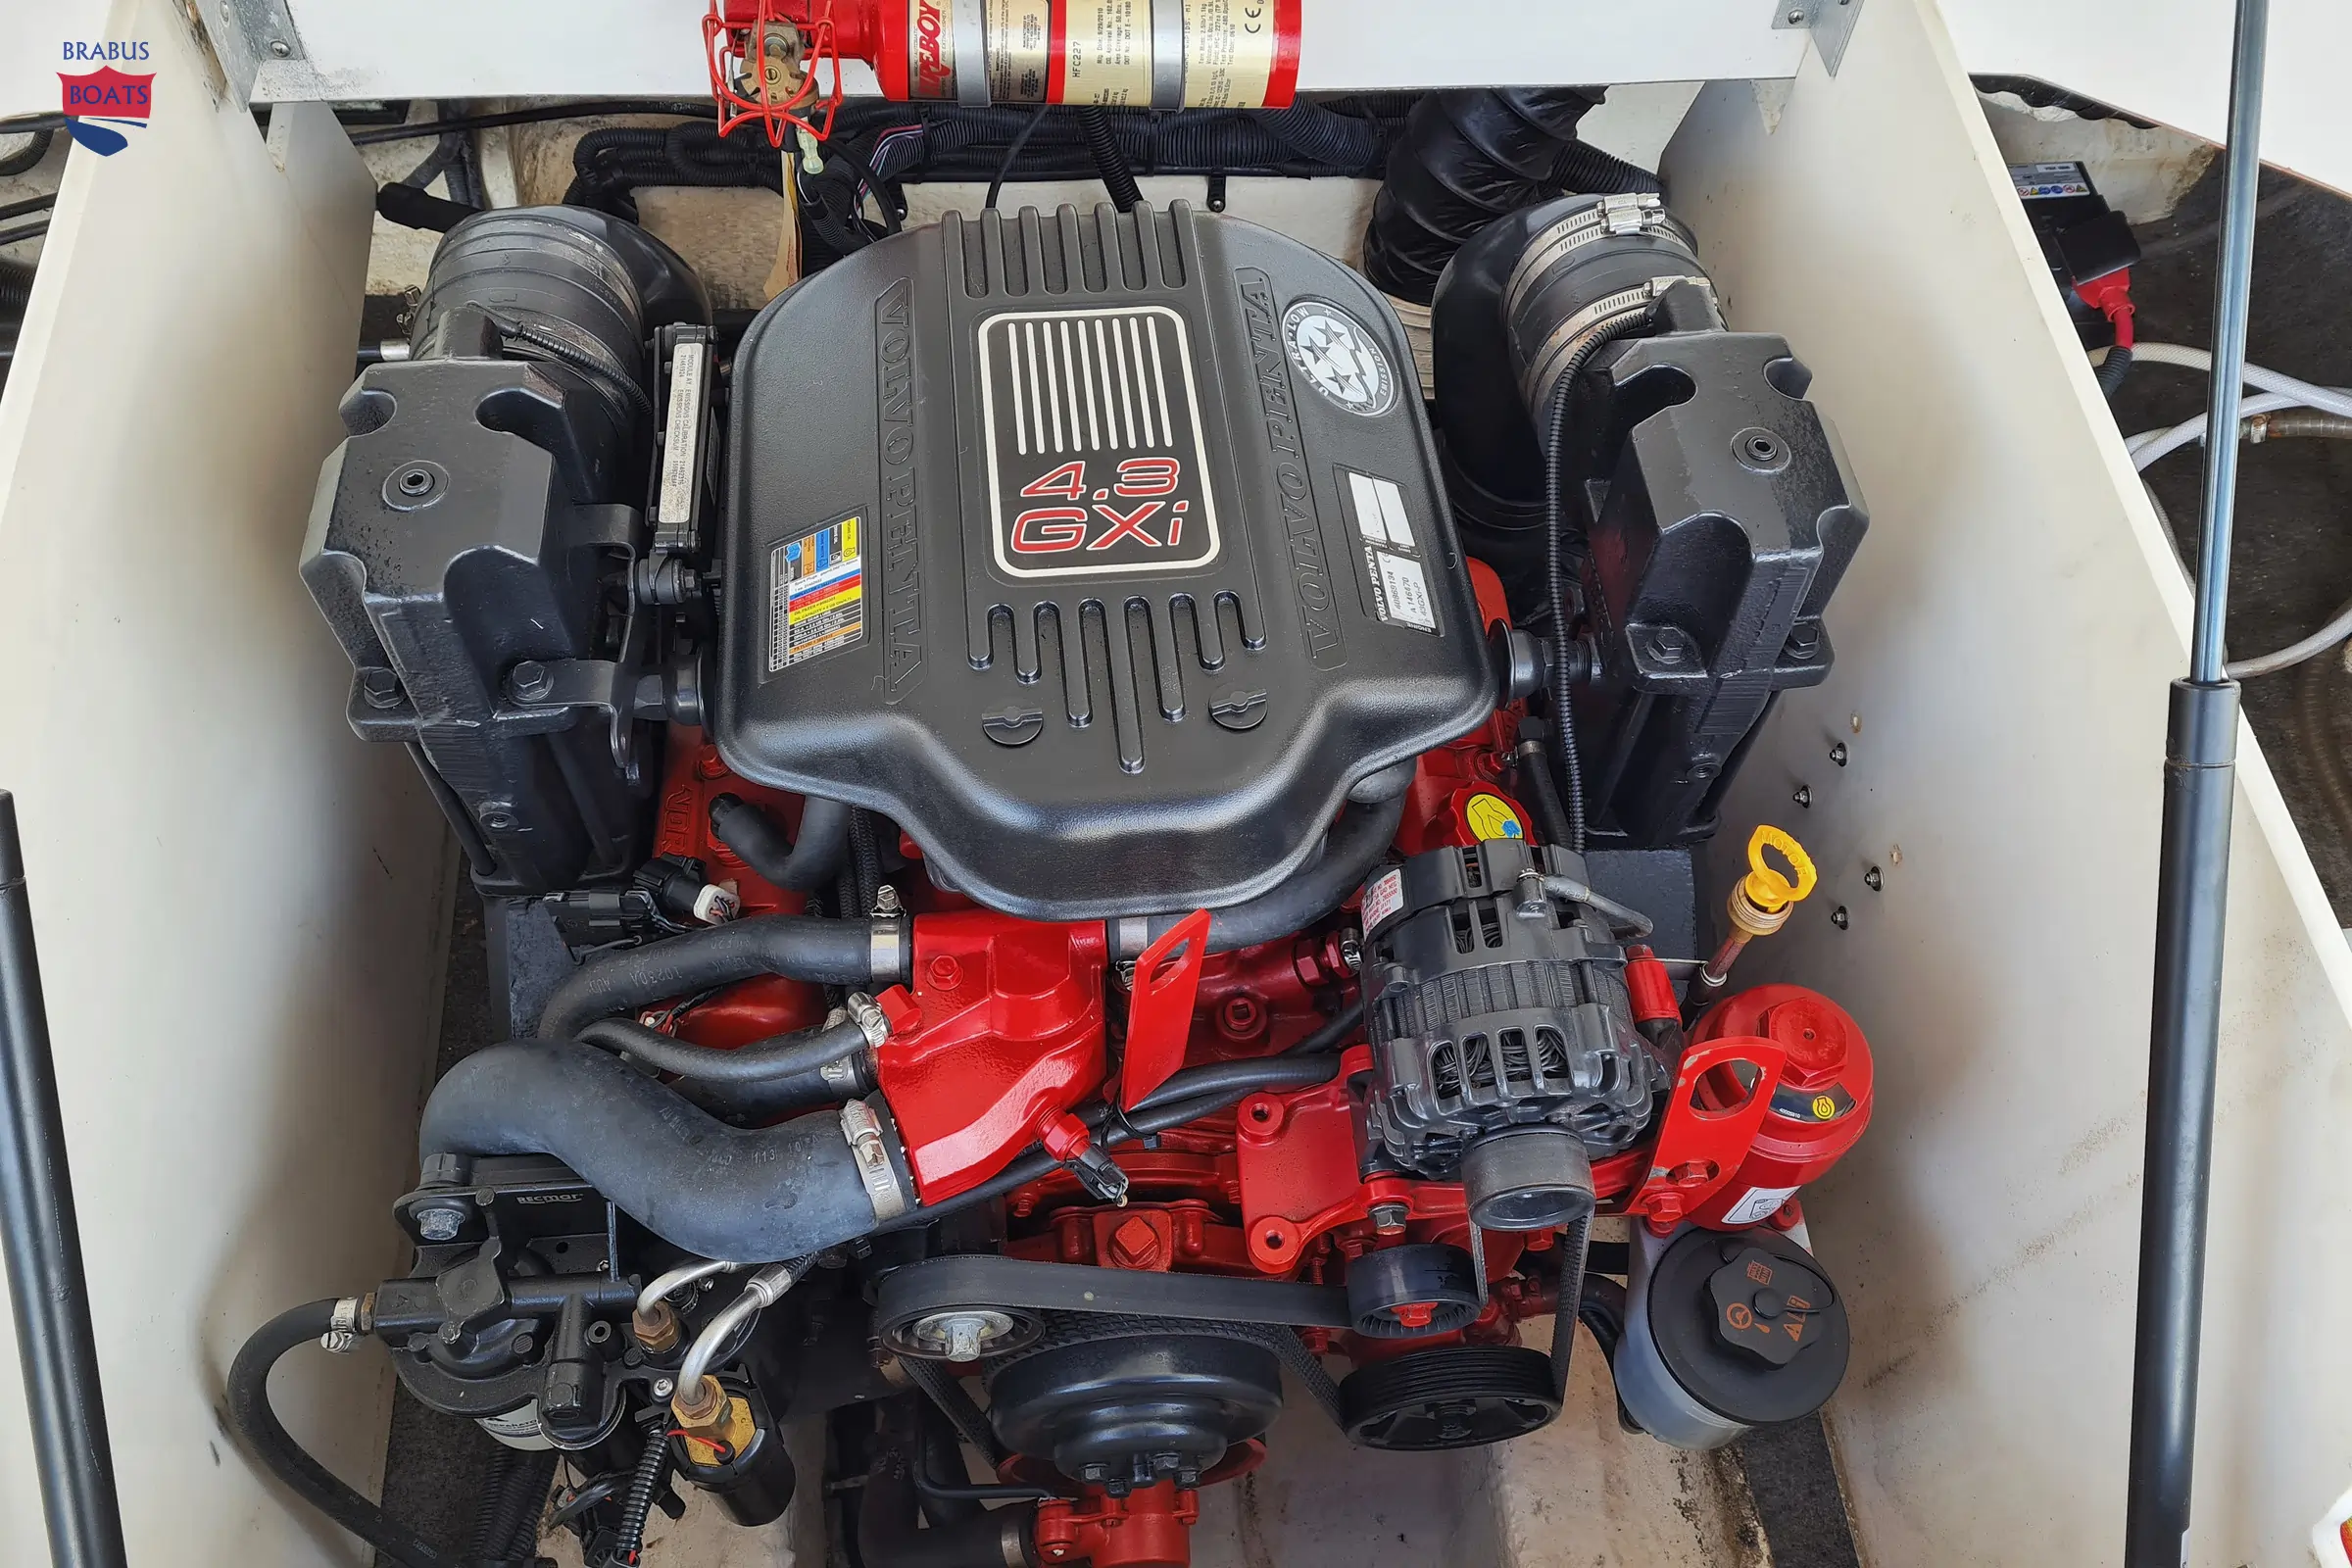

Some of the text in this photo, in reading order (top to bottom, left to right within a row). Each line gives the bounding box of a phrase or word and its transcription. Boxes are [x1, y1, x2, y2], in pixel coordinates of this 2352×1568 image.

[1072, 41, 1081, 77] HFC227
[686, 354, 695, 377] MODULE
[1368, 346, 1390, 398] EMISSION
[675, 389, 684, 418] EMISSIONS
[683, 389, 692, 418] EMISSIONS
[672, 419, 682, 451] CHECKSUM
[680, 419, 690, 457] CALIBRATION
[1020, 457, 1180, 501] 4.3
[1241, 276, 1339, 660] VOLVO PENTA
[881, 285, 924, 692] VOLVO PENTA
[1011, 501, 1189, 553] GXi
[1364, 546, 1389, 622] VOLVO PENTA
[1406, 621, 1432, 633] ENGINE
